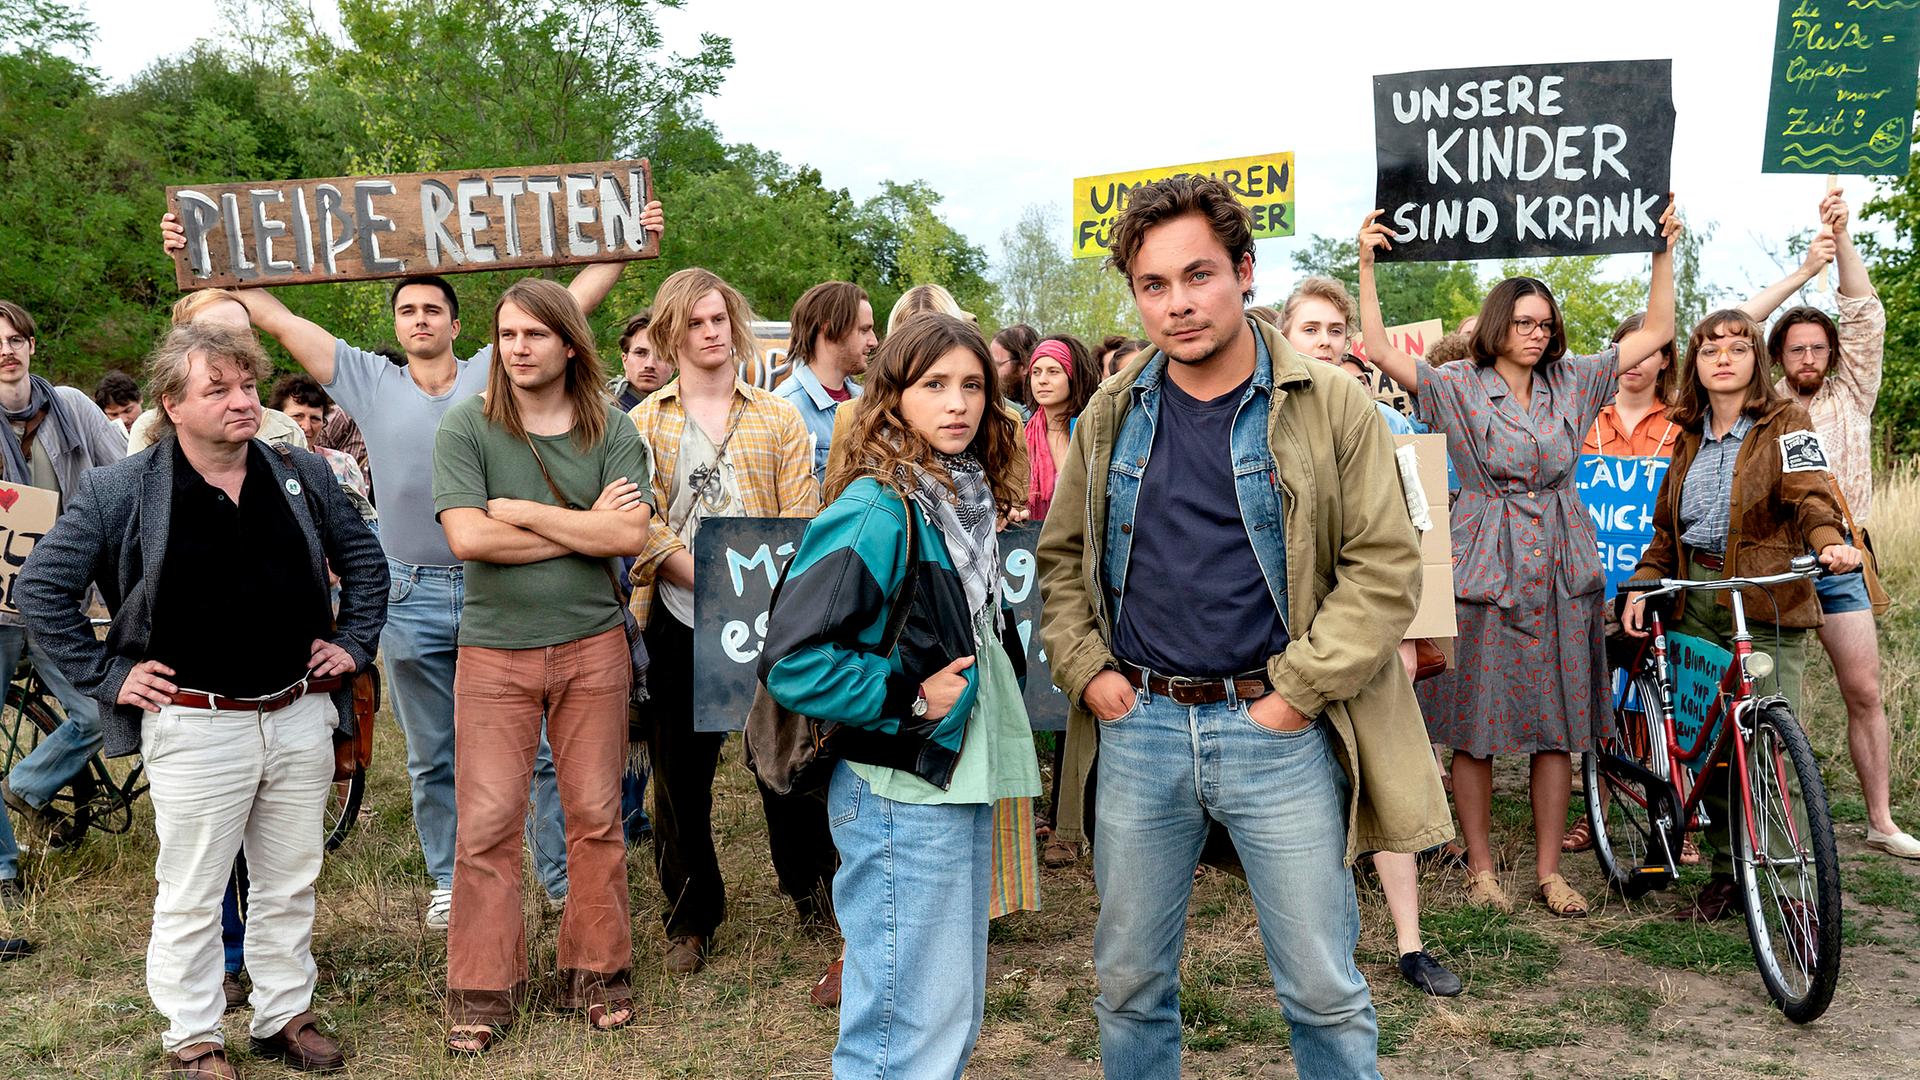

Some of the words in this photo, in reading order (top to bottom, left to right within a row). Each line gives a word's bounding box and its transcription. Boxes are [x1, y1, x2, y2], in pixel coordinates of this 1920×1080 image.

[1787, 20, 1874, 50] Pleiße
[1392, 75, 1564, 124] UNSERE
[1427, 124, 1631, 184] KINDER
[419, 166, 647, 268] RETTEN
[1393, 198, 1499, 244] SIND
[1516, 188, 1660, 244] KRANK
[1588, 502, 1657, 532] NICH
